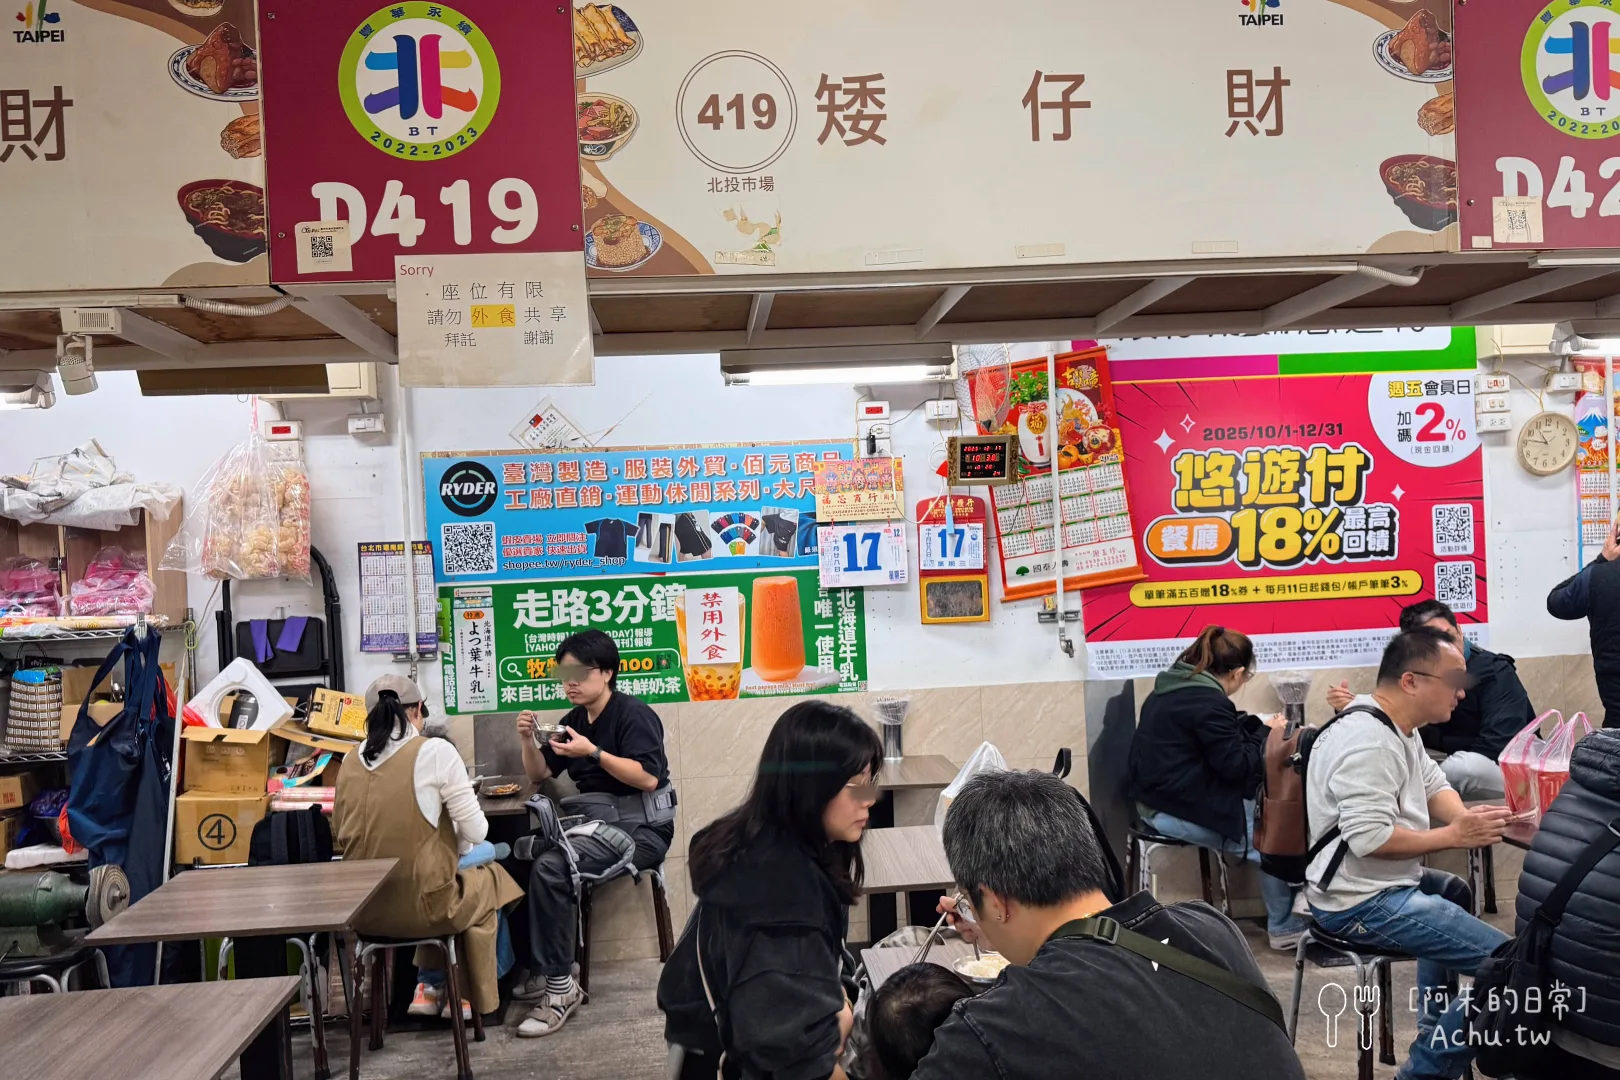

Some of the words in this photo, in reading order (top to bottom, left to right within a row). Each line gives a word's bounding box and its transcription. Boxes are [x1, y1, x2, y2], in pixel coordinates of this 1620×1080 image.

[1238, 14, 1284, 26] TAIPEI
[14, 30, 66, 43] TAIPEI
[697, 94, 776, 131] 419
[815, 67, 1292, 147] 矮仔財
[1581, 108, 1606, 116] BT
[409, 127, 438, 136] BT
[371, 127, 477, 156] 2022-2023
[707, 176, 774, 193] 北投市場
[312, 178, 538, 248] D419
[400, 264, 434, 277] Sorry
[442, 281, 544, 301] 座位有限
[444, 331, 476, 348] 拜託
[523, 330, 554, 346] 謝謝
[1388, 380, 1470, 398] 週五會員日
[1397, 411, 1411, 443] 加碼
[1416, 402, 1467, 442] 2%
[1536, 421, 1541, 429] 11
[1544, 418, 1552, 426] 12
[1203, 423, 1344, 441] 2025/10/1-12/31
[1528, 429, 1534, 437] 10
[1562, 428, 1567, 436] 2
[1565, 439, 1570, 447] 3
[1533, 457, 1539, 465] 7
[1552, 457, 1557, 465] 5
[1174, 446, 1367, 510] 悠遊付
[441, 481, 496, 496] RYDER
[1344, 508, 1391, 530] 最高
[938, 528, 965, 558] 17
[1161, 525, 1218, 551] 餐廳
[1231, 507, 1351, 563] 18%
[1343, 530, 1391, 554] 回饋
[843, 532, 882, 572] 17
[1144, 584, 1248, 600] 單筆滿五百贈18%券
[513, 583, 687, 629] 走路3分鐘
[701, 592, 727, 661] 禁用外食
[837, 588, 859, 682] 北海道牛乳
[469, 621, 484, 693] よつ葉牛乳
